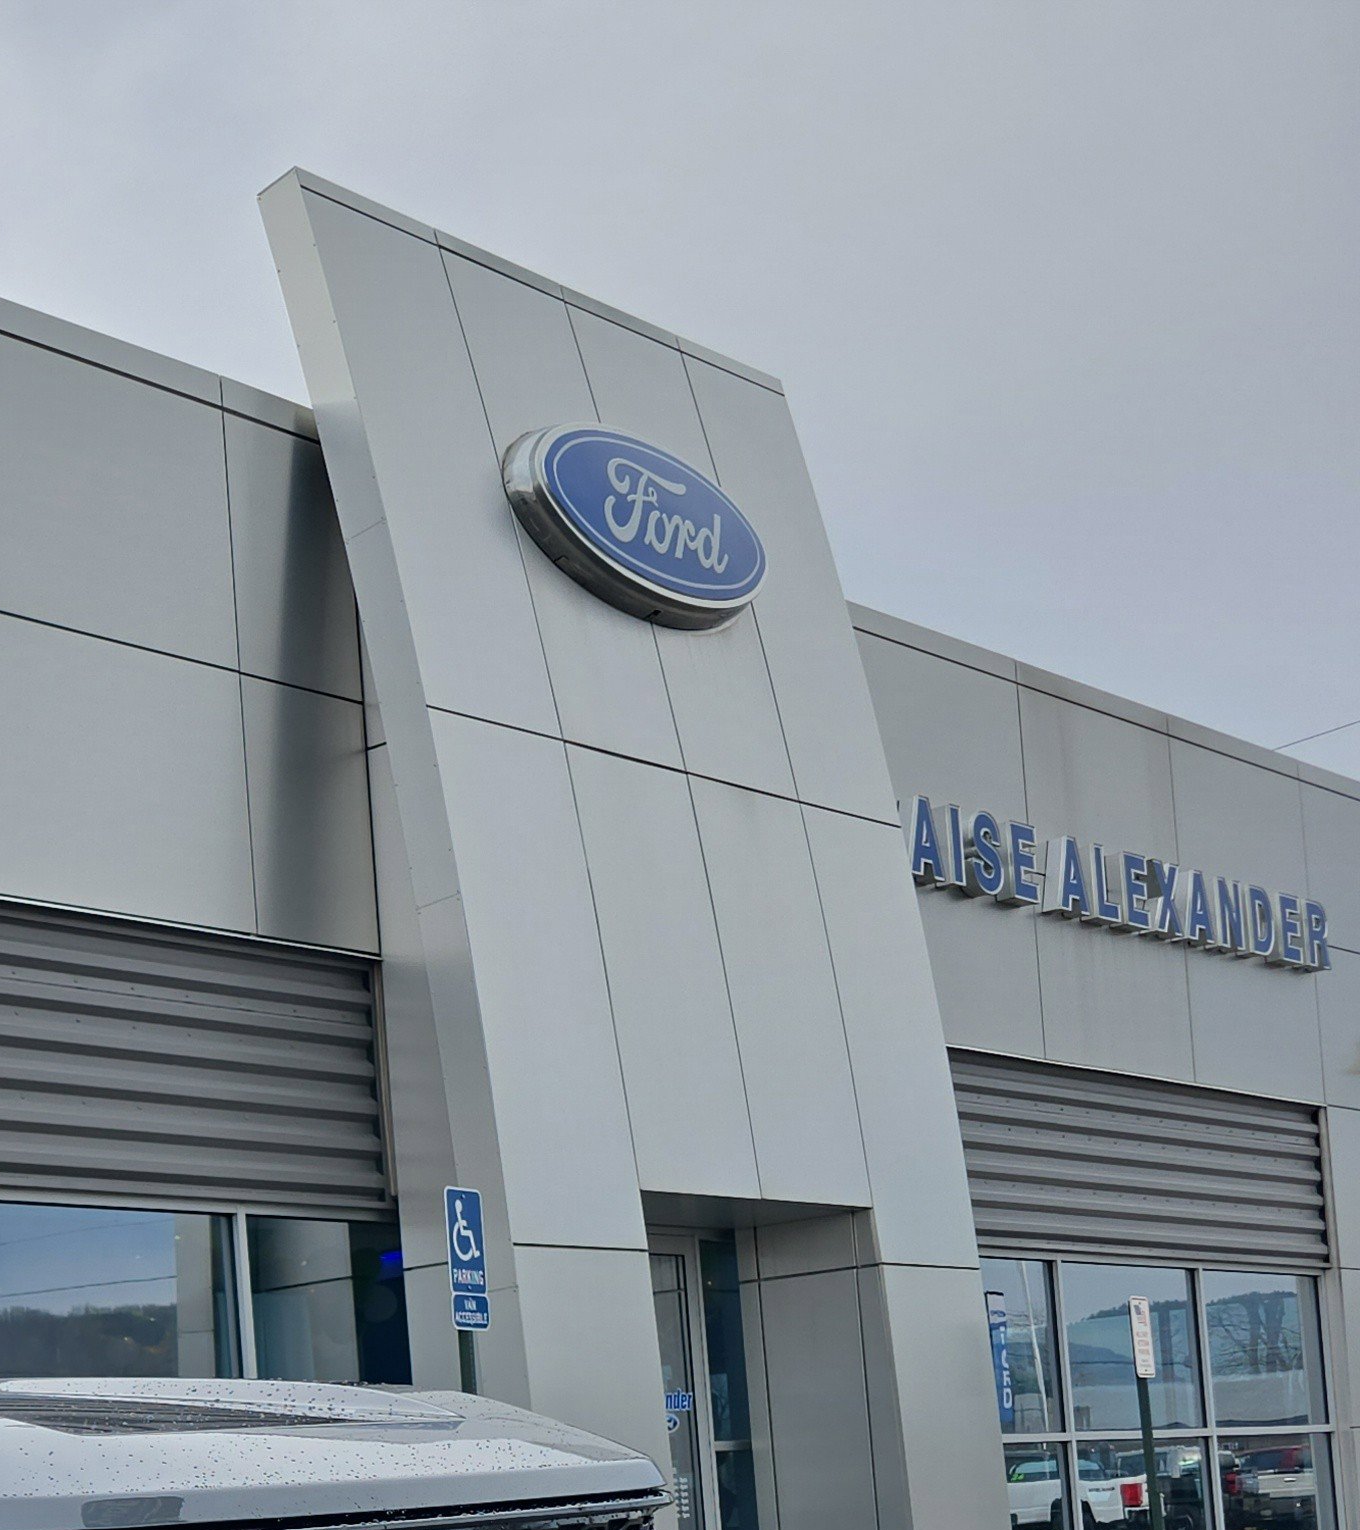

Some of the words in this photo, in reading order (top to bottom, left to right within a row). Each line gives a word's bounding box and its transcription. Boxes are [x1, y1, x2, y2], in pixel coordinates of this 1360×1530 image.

[604, 457, 728, 574] Ford
[911, 795, 1040, 905] AISE
[1045, 835, 1332, 970] ALEXANDER
[453, 1269, 484, 1286] PARKING
